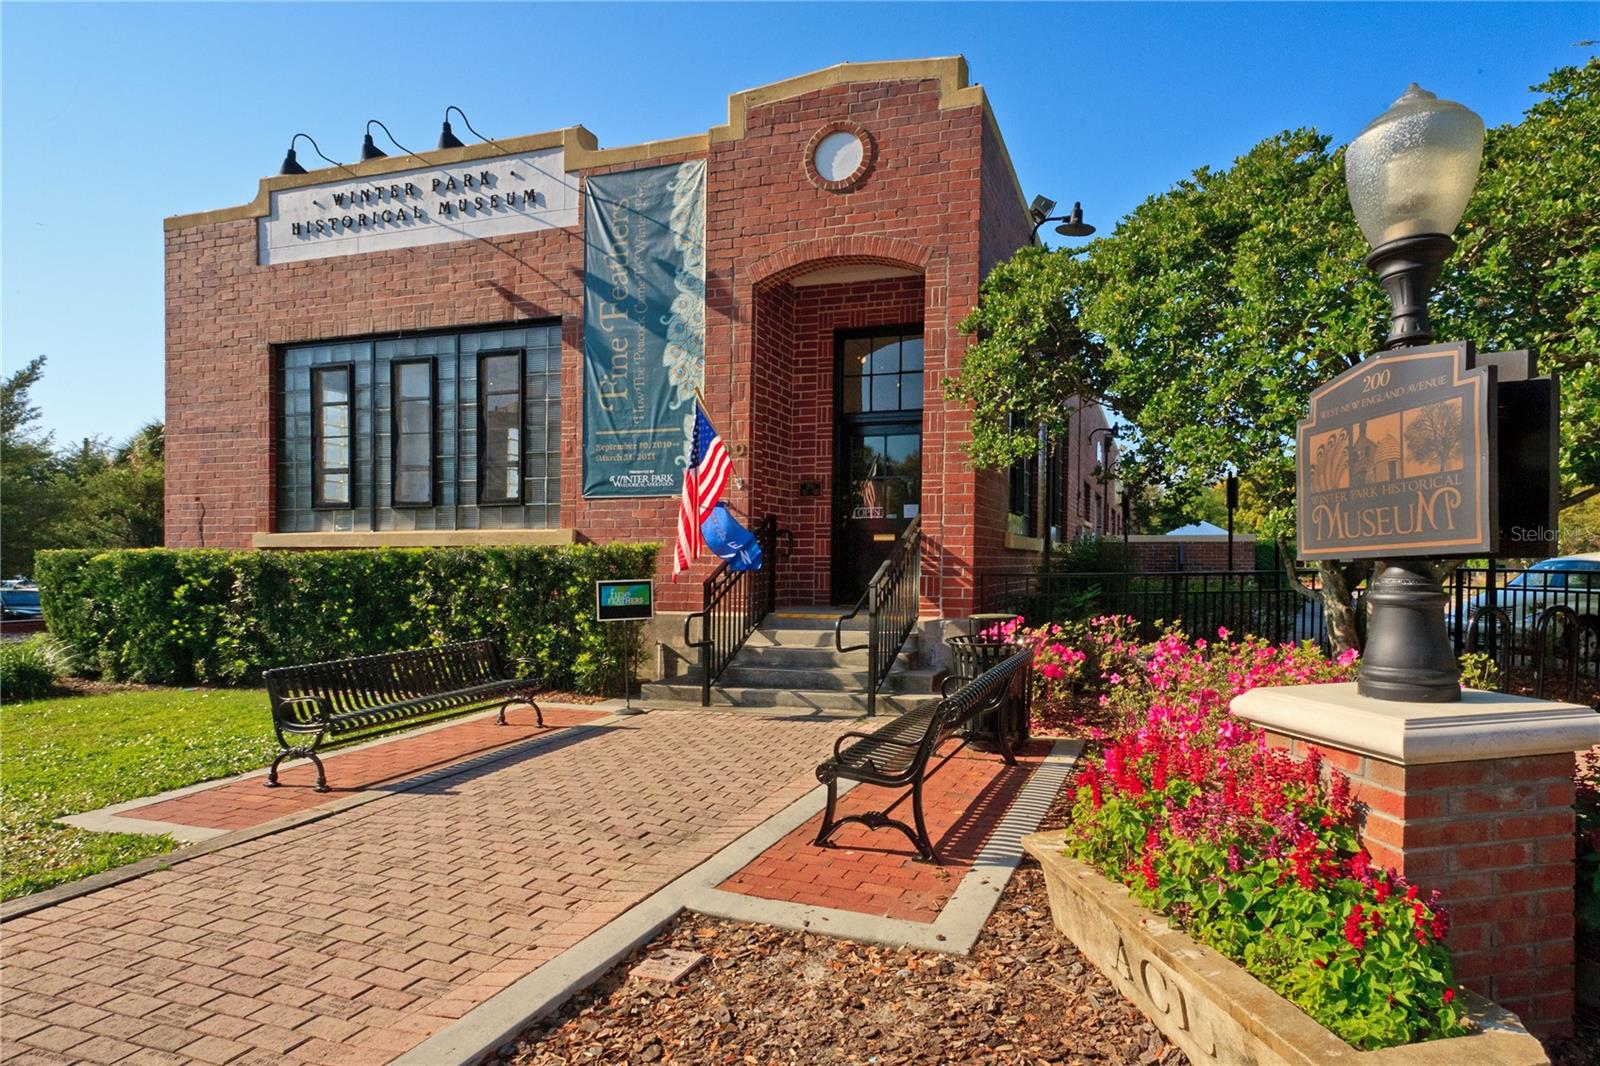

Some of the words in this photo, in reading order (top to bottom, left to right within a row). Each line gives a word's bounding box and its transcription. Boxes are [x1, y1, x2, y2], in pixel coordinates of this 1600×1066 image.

[332, 182, 414, 206] WINTER
[432, 170, 490, 191] PARK
[291, 205, 422, 236] HISTORICAL
[438, 188, 537, 215] MUSEUM
[599, 197, 629, 332] Feathers
[598, 336, 629, 412] Fine
[1361, 368, 1391, 393] 200
[1321, 409, 1339, 419] WEST
[1341, 401, 1361, 413] NEW
[1361, 387, 1405, 407] ENGLAND
[1406, 374, 1449, 394] AVENUE
[596, 442, 638, 452] September
[652, 440, 672, 449] 2010
[596, 454, 623, 462] March
[609, 475, 649, 487] WINTER
[651, 473, 674, 482] PARK
[1311, 492, 1347, 505] WINTER
[1351, 487, 1377, 500] PARK
[1381, 474, 1463, 496] HISTORICAL
[856, 507, 881, 517] OPEN
[1311, 486, 1462, 541] MUSEUM
